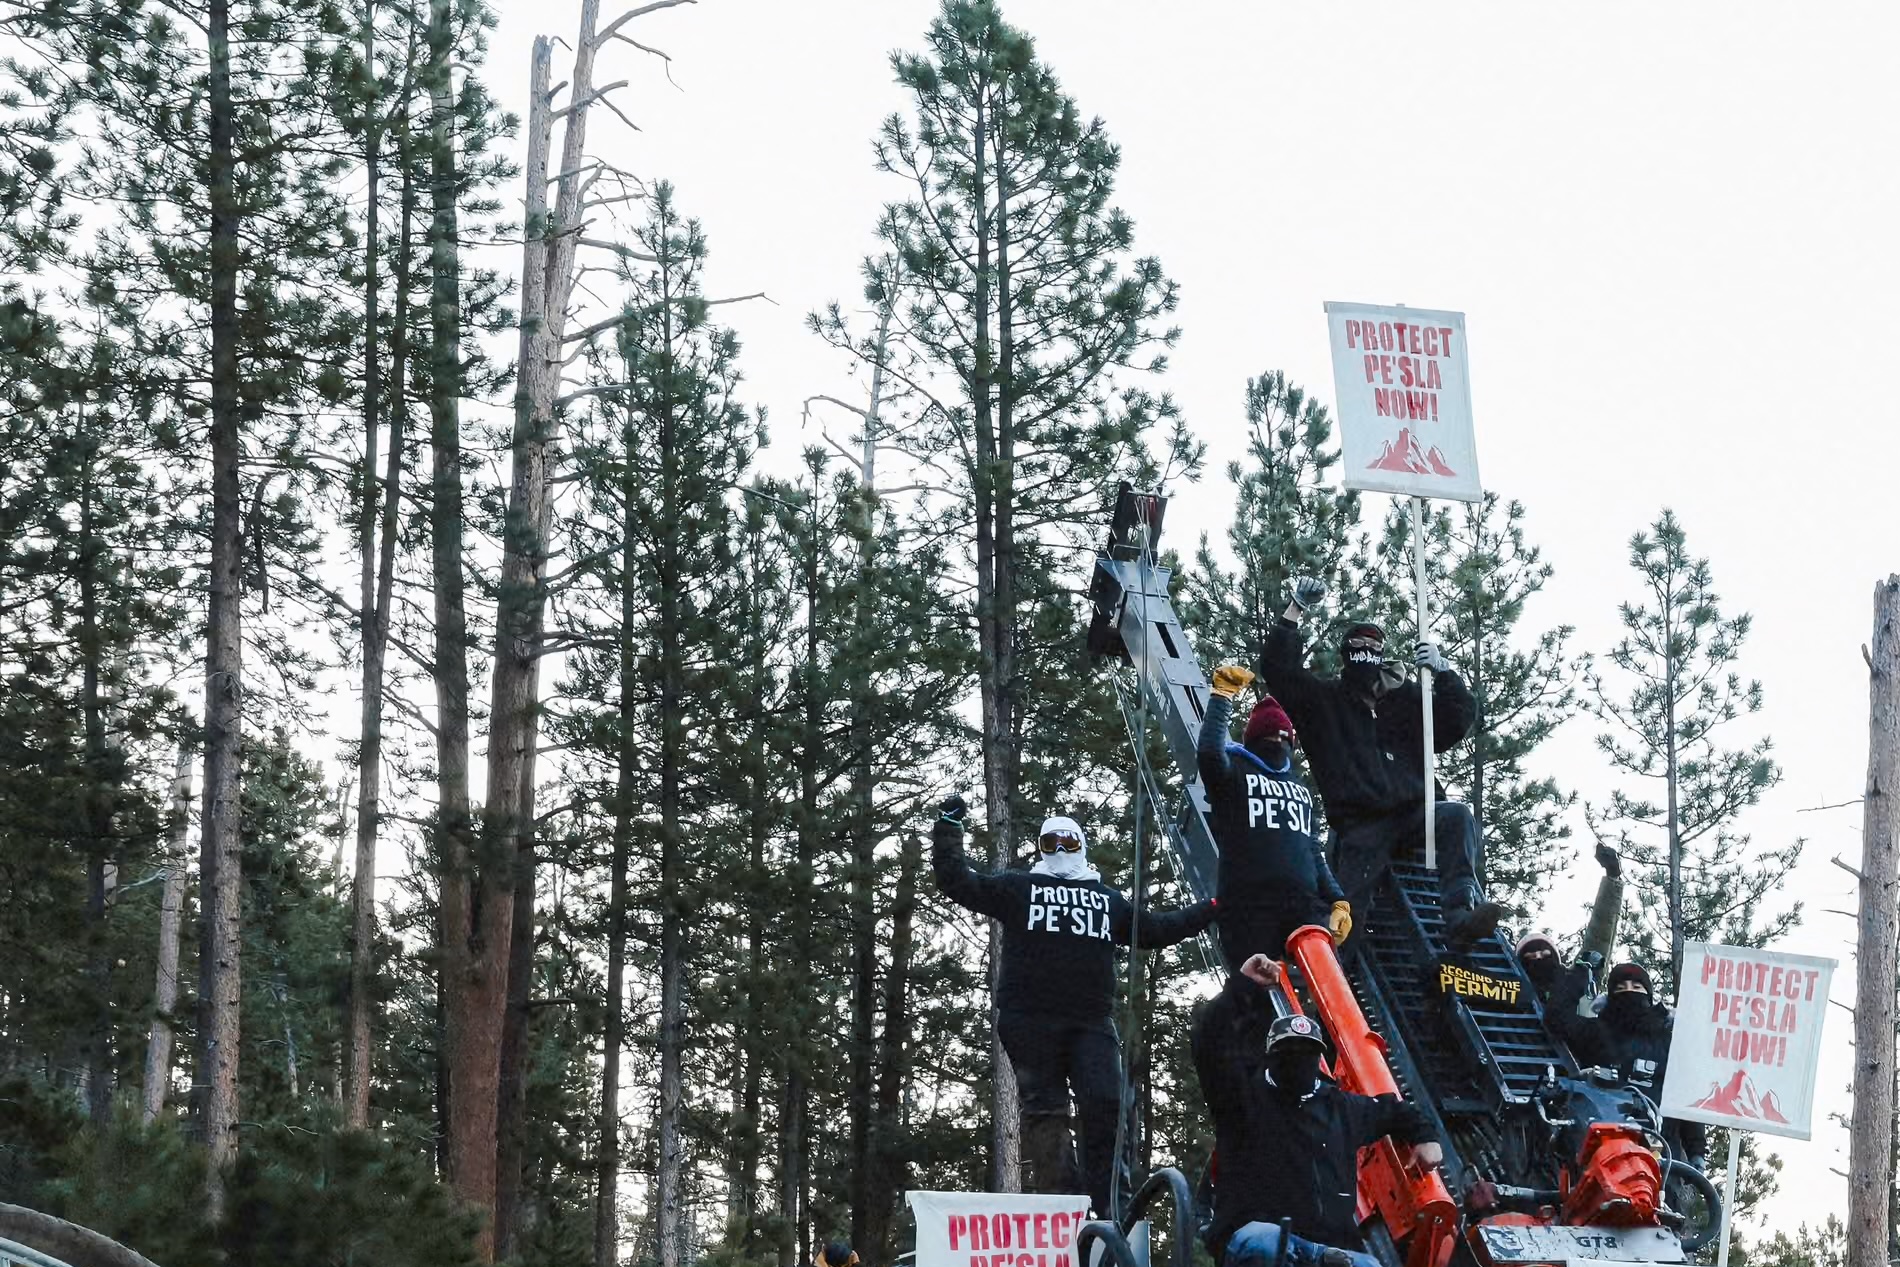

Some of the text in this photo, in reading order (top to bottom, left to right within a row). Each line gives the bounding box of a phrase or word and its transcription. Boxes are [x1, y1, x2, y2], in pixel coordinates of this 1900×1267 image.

[1345, 319, 1453, 358] PROTECT
[1363, 353, 1442, 390] PE'SLA
[1375, 387, 1439, 422] NOW!
[1245, 773, 1313, 808] PROTECT
[1030, 883, 1110, 913] PROTECT
[1027, 904, 1112, 941] PE'SLA
[1440, 974, 1517, 1004] PERMIT
[1700, 954, 1819, 1002] PROTECT
[1711, 991, 1797, 1034] PE'SLA
[1712, 1027, 1787, 1068] NOW!
[1576, 1236, 1618, 1249] GT8
